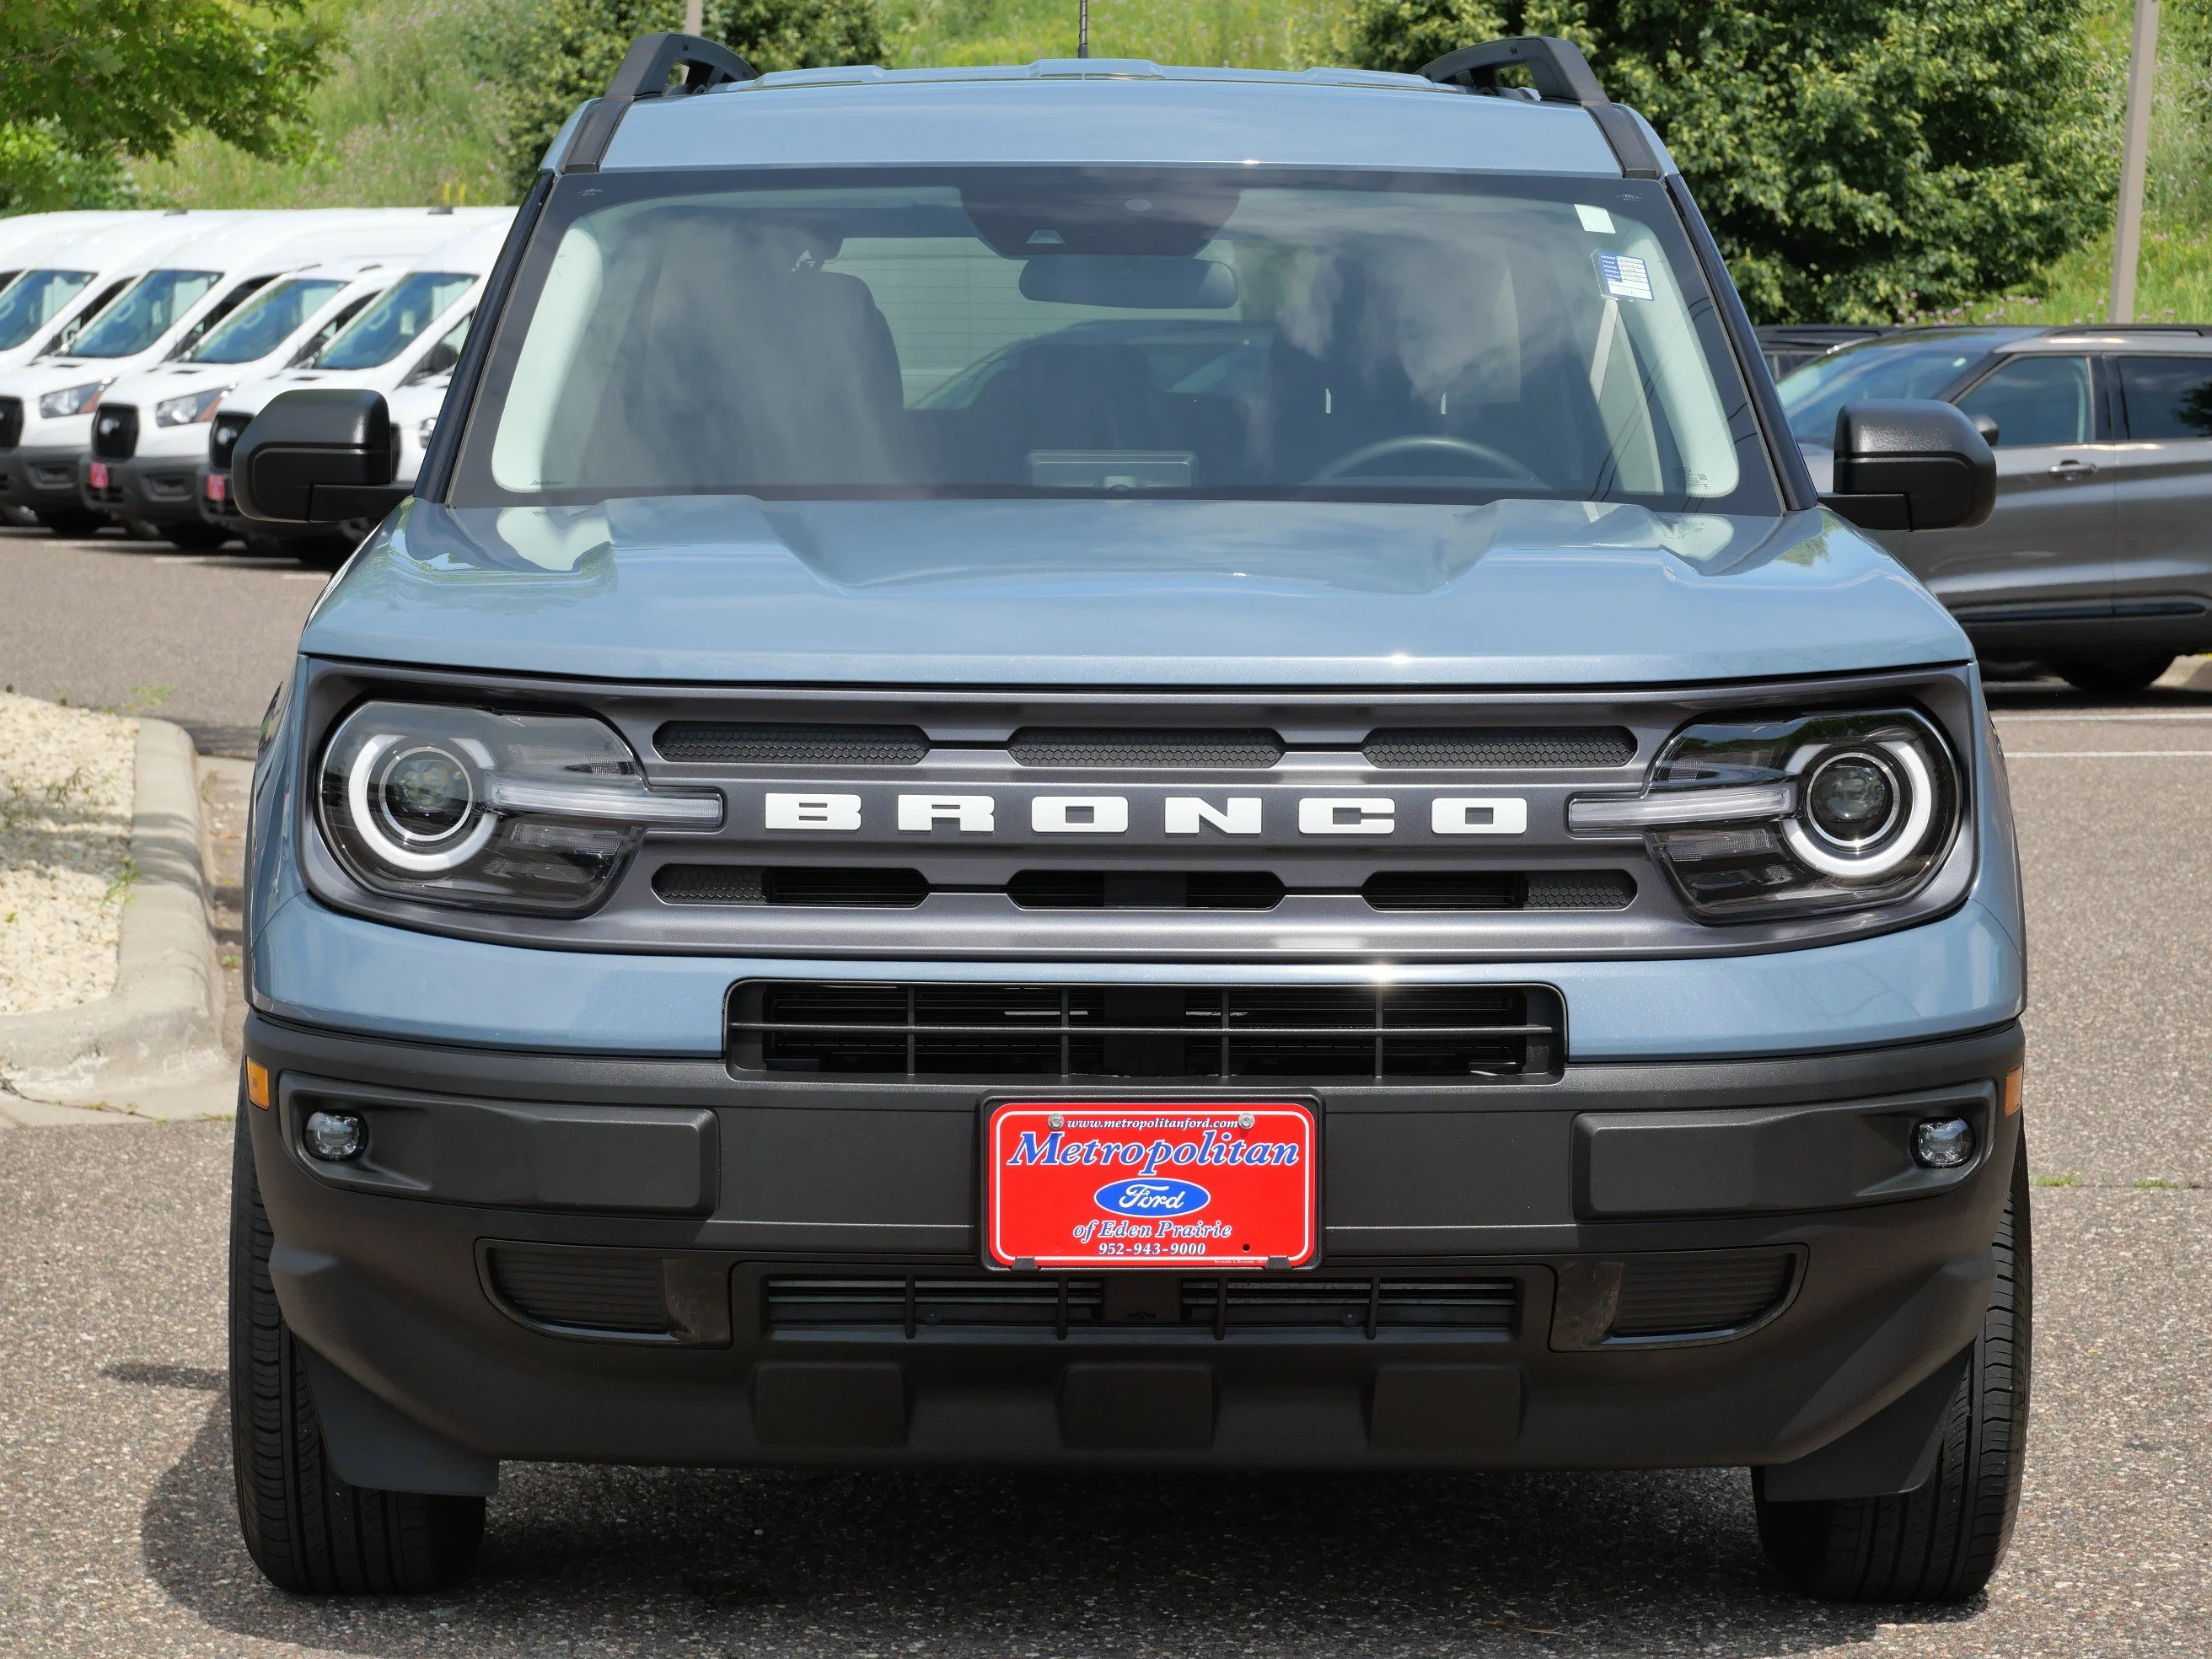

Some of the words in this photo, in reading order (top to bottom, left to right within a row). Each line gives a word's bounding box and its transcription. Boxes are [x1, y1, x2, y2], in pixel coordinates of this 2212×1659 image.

[764, 792, 1528, 835] BRONCO
[1066, 1117, 1238, 1130] www.metropolitanford.com
[1007, 1130, 1300, 1176] Metropolitan
[1118, 1183, 1186, 1210] Ford
[1072, 1219, 1099, 1244] of
[1098, 1219, 1152, 1238] Eden
[1154, 1219, 1233, 1238] Prairie
[1098, 1242, 1206, 1255] 952-943-9000
